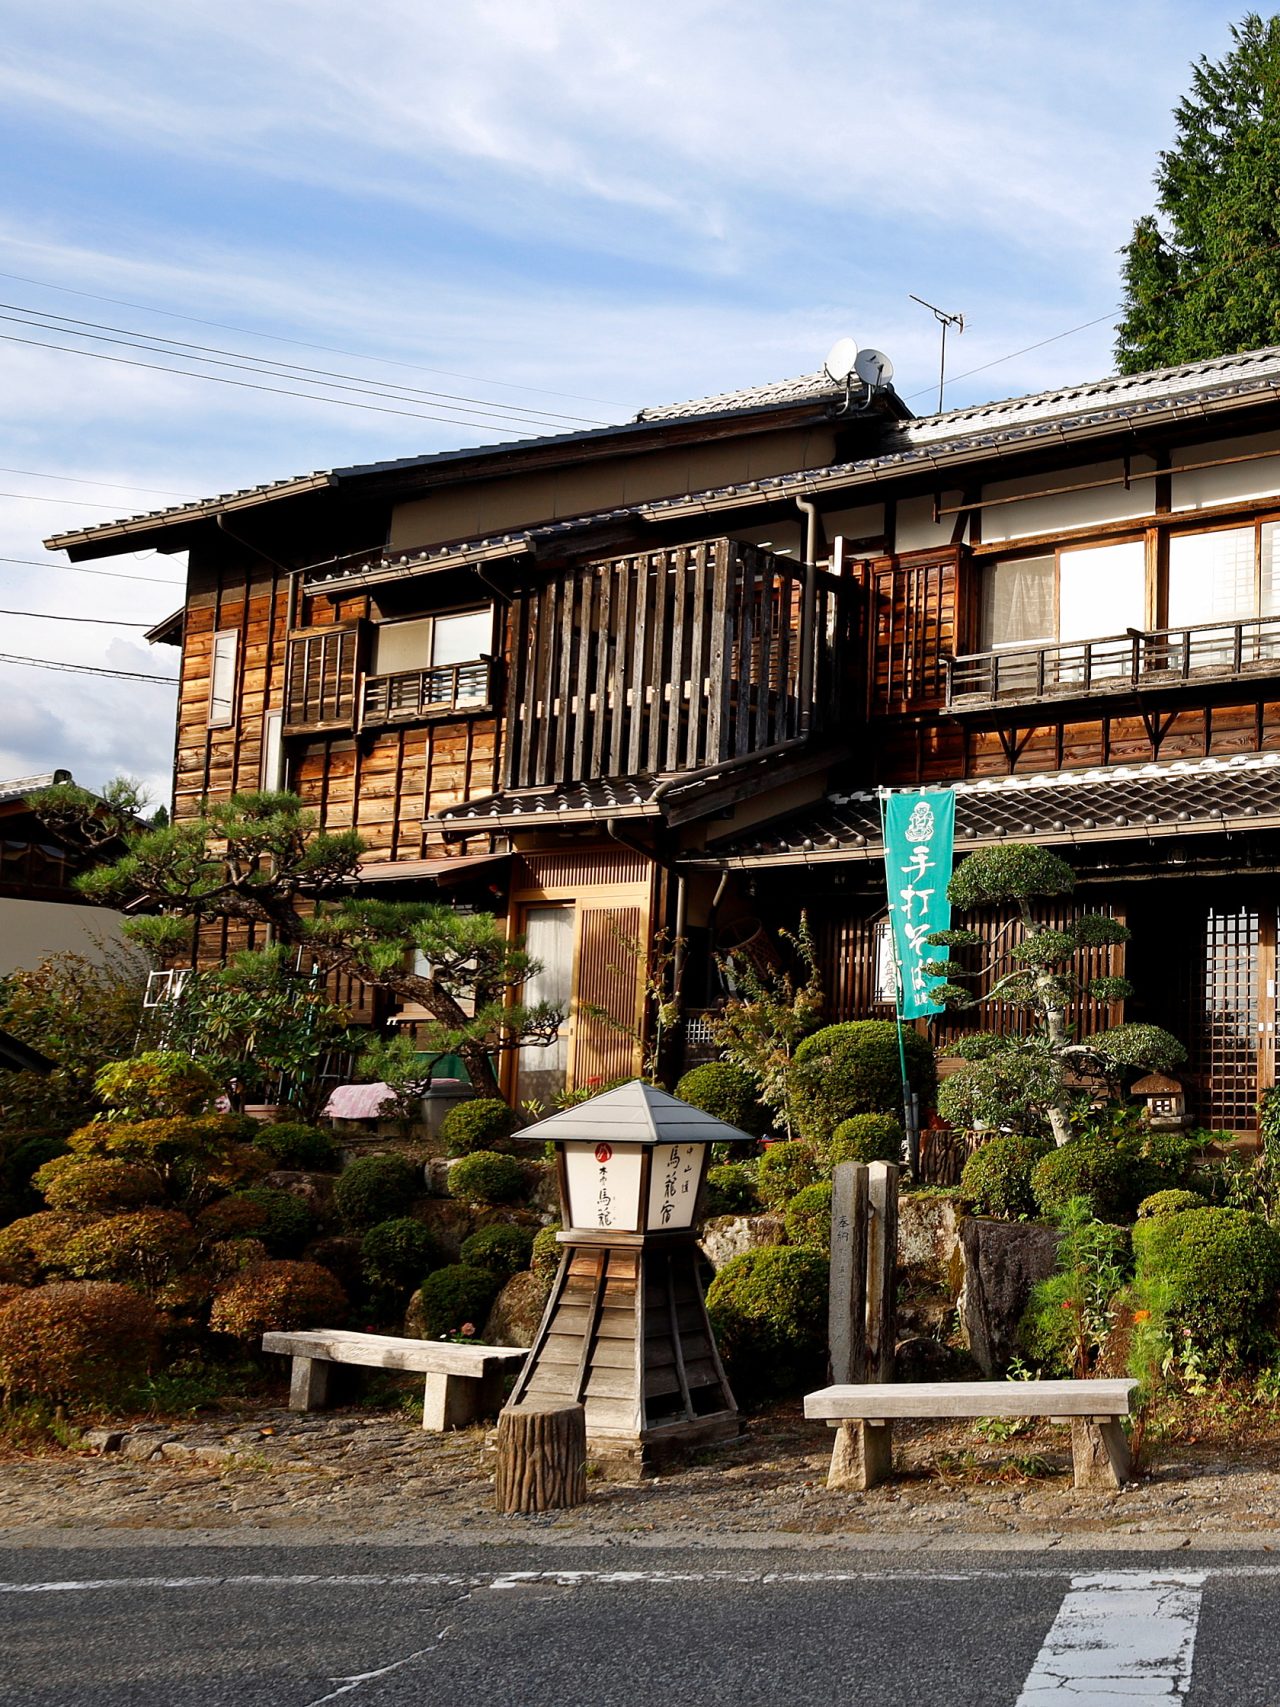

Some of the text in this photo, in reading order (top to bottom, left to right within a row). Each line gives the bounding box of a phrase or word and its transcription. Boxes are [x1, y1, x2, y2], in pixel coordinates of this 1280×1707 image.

[900, 846, 936, 990] 手打そば
[660, 1145, 681, 1225] 馬籠宿
[681, 1145, 694, 1194] 中山道
